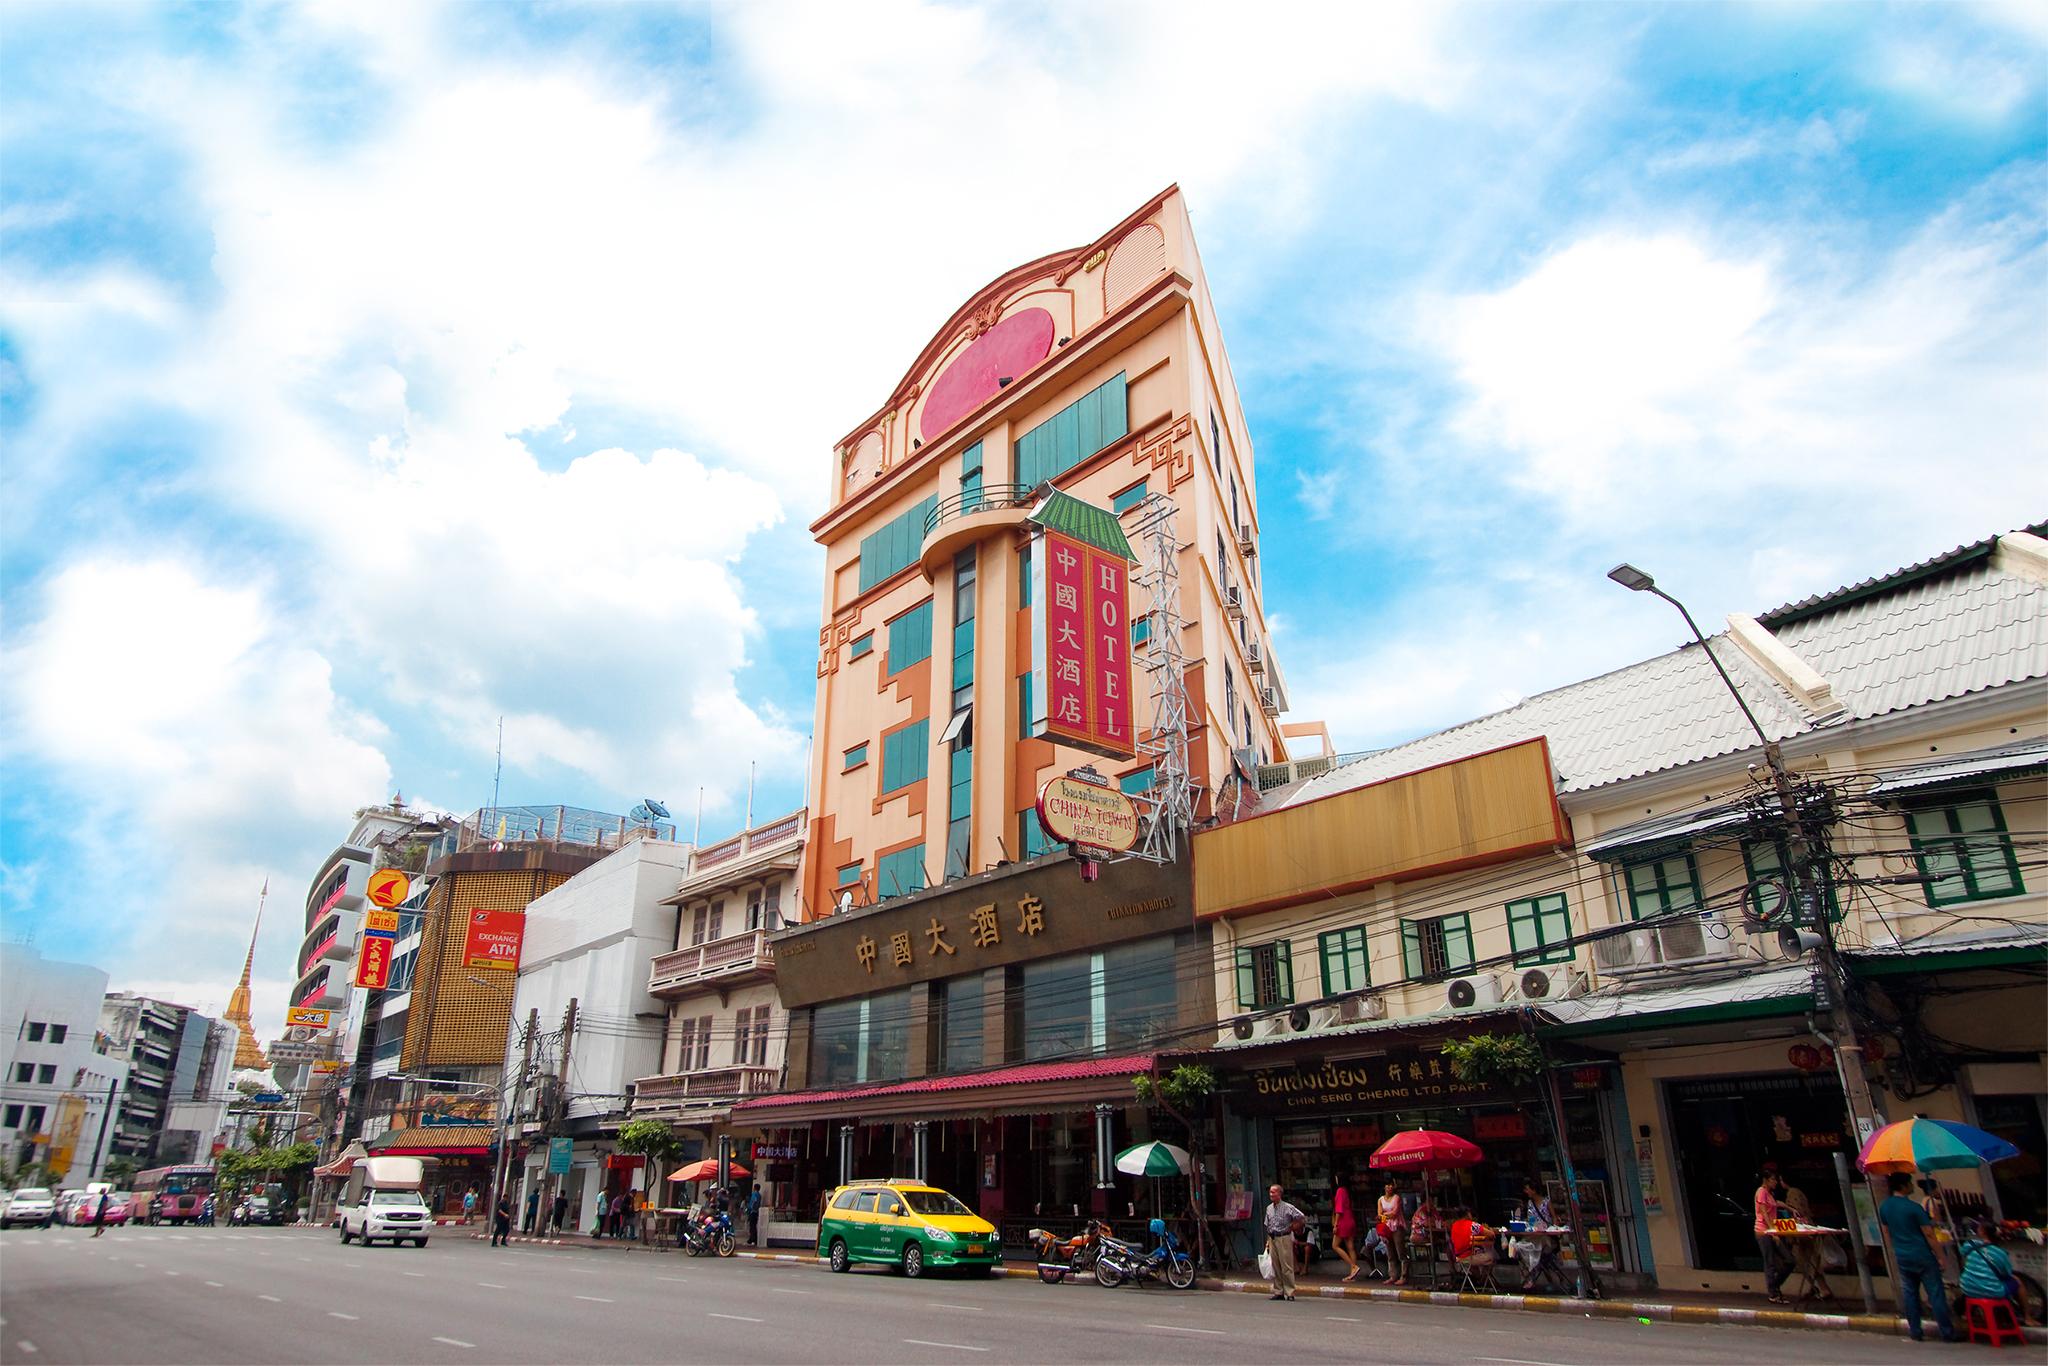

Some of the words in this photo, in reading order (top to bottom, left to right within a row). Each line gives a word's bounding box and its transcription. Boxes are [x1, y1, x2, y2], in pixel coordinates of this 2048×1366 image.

[1055, 547, 1082, 724] 中國大酒店
[1099, 563, 1121, 737] HOTEL
[1049, 797, 1092, 822] CHINA
[1095, 808, 1132, 831] TOWN
[1073, 823, 1113, 842] HOTEL
[478, 932, 519, 944] EXCHANGE
[856, 891, 1046, 975] 中國大酒店
[488, 943, 517, 957] ATM
[1287, 1095, 1316, 1106] CHIN
[1320, 1092, 1353, 1104] SENG
[1357, 1087, 1409, 1101] CHEANG
[1774, 1219, 1797, 1232] 100
